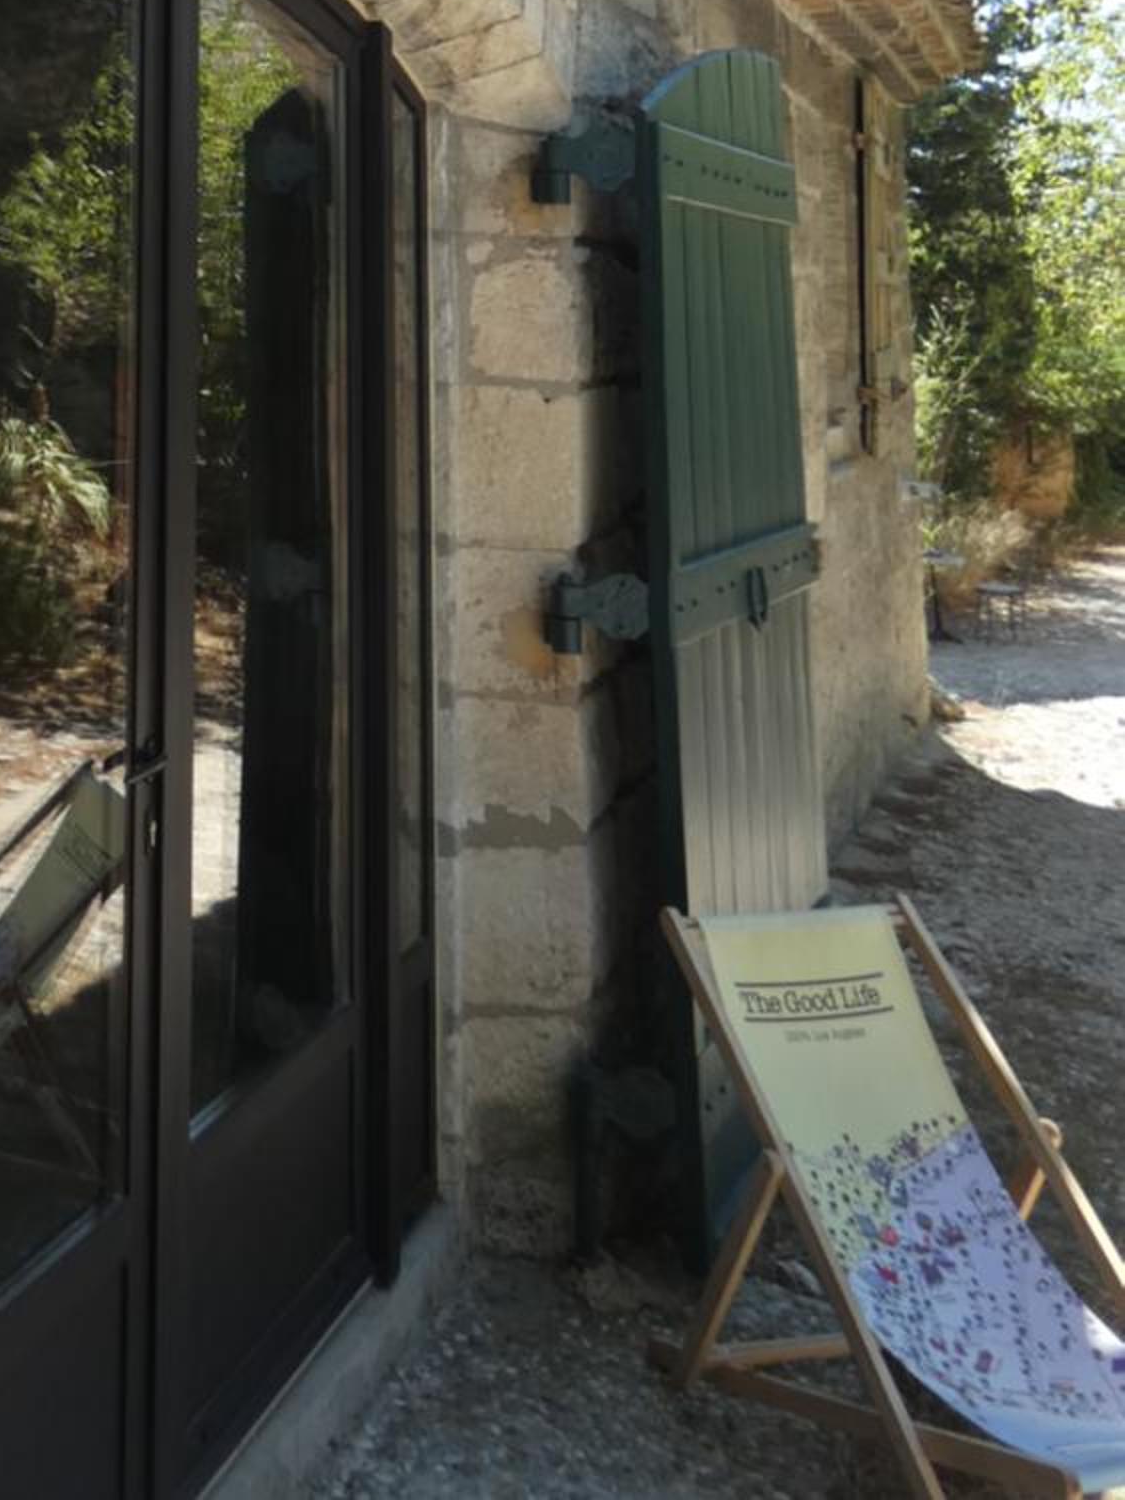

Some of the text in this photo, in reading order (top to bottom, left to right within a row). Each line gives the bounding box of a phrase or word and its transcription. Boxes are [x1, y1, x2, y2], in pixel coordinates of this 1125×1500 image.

[739, 983, 881, 1013] The Good Life
